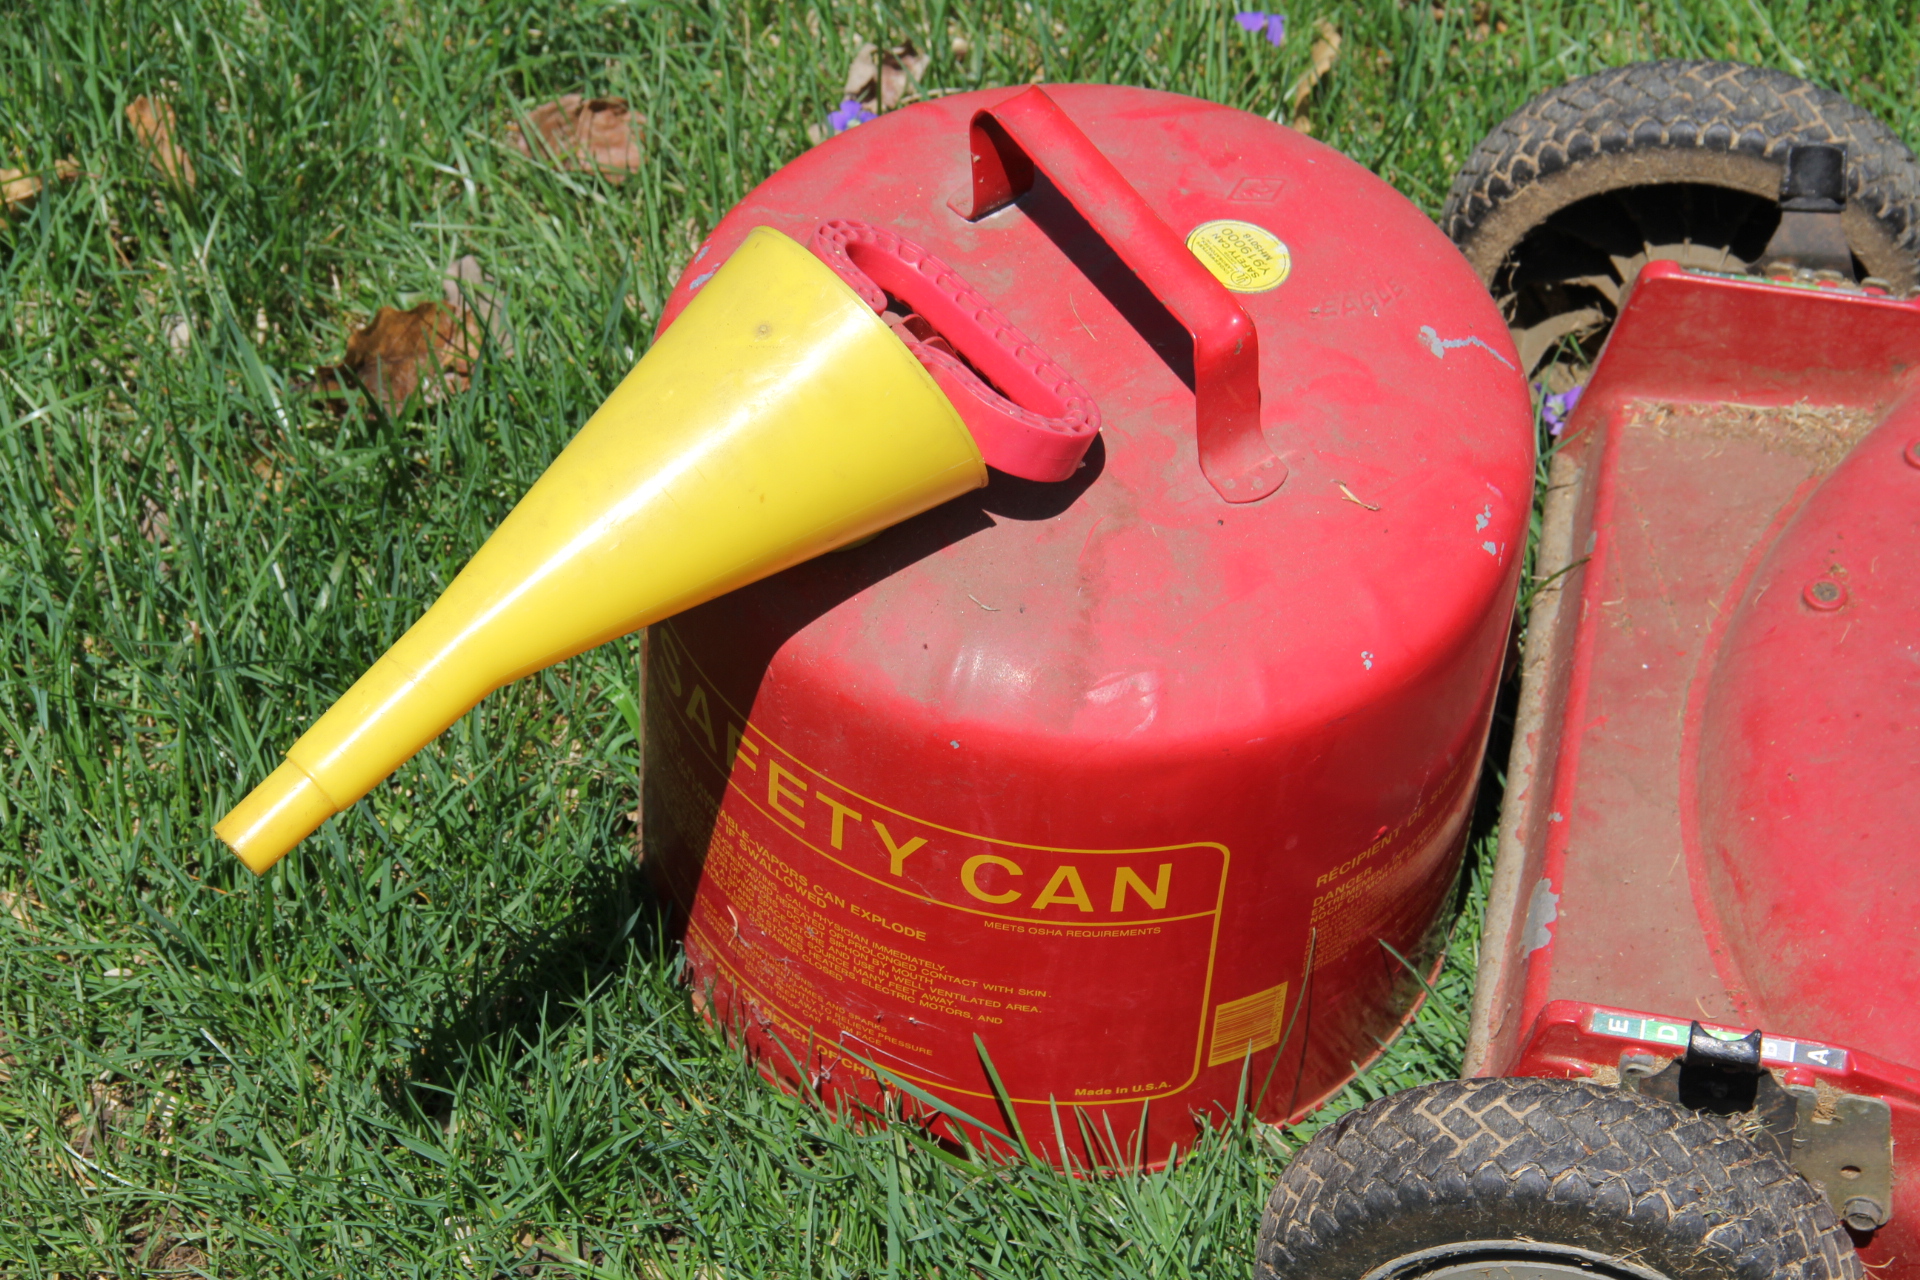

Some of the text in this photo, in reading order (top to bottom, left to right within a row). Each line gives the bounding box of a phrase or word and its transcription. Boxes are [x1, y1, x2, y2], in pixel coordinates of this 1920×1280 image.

[1211, 232, 1230, 249] CAN
[1228, 249, 1260, 278] SAFETY
[660, 626, 928, 877] SAFETY
[960, 854, 1173, 913] CAN
[737, 831, 827, 909] SWALLOWED
[1312, 865, 1372, 907] DANGER
[783, 892, 810, 914] CALL
[811, 910, 869, 945] PHYSICIAN
[810, 883, 845, 909] CAN
[849, 902, 927, 942] EXPLODE
[984, 920, 1161, 938] MEETS OSHA REQUIREMENTS
[774, 893, 826, 931] REPEATED
[827, 928, 845, 942] OR
[846, 937, 917, 972] PROLONGED
[920, 967, 979, 988] CONTACT
[981, 982, 1014, 994] WITH
[800, 952, 845, 983] CLOSED.
[828, 935, 869, 962] SIPHON
[870, 956, 888, 969] BY
[890, 964, 934, 985] MOUTH
[806, 940, 849, 969] SOURCE
[852, 964, 885, 984] MANY
[887, 979, 917, 996] FEET
[920, 991, 957, 1008] AWAY.
[827, 944, 850, 961] AND
[852, 956, 875, 973] USE
[877, 967, 890, 979] IN
[892, 973, 925, 991] WELL
[928, 985, 1002, 1008] VENTILATED
[1004, 1002, 1042, 1013] AREA.
[860, 976, 916, 1004] ELECTRIC
[976, 1013, 1003, 1025] AND
[816, 1044, 839, 1059] OF
[876, 1031, 933, 1056] PRESSURE
[1608, 1018, 1629, 1033] E
[1656, 1025, 1678, 1041] D
[1807, 1049, 1829, 1065] A
[1074, 1081, 1172, 1096] Made in U.S.A.
